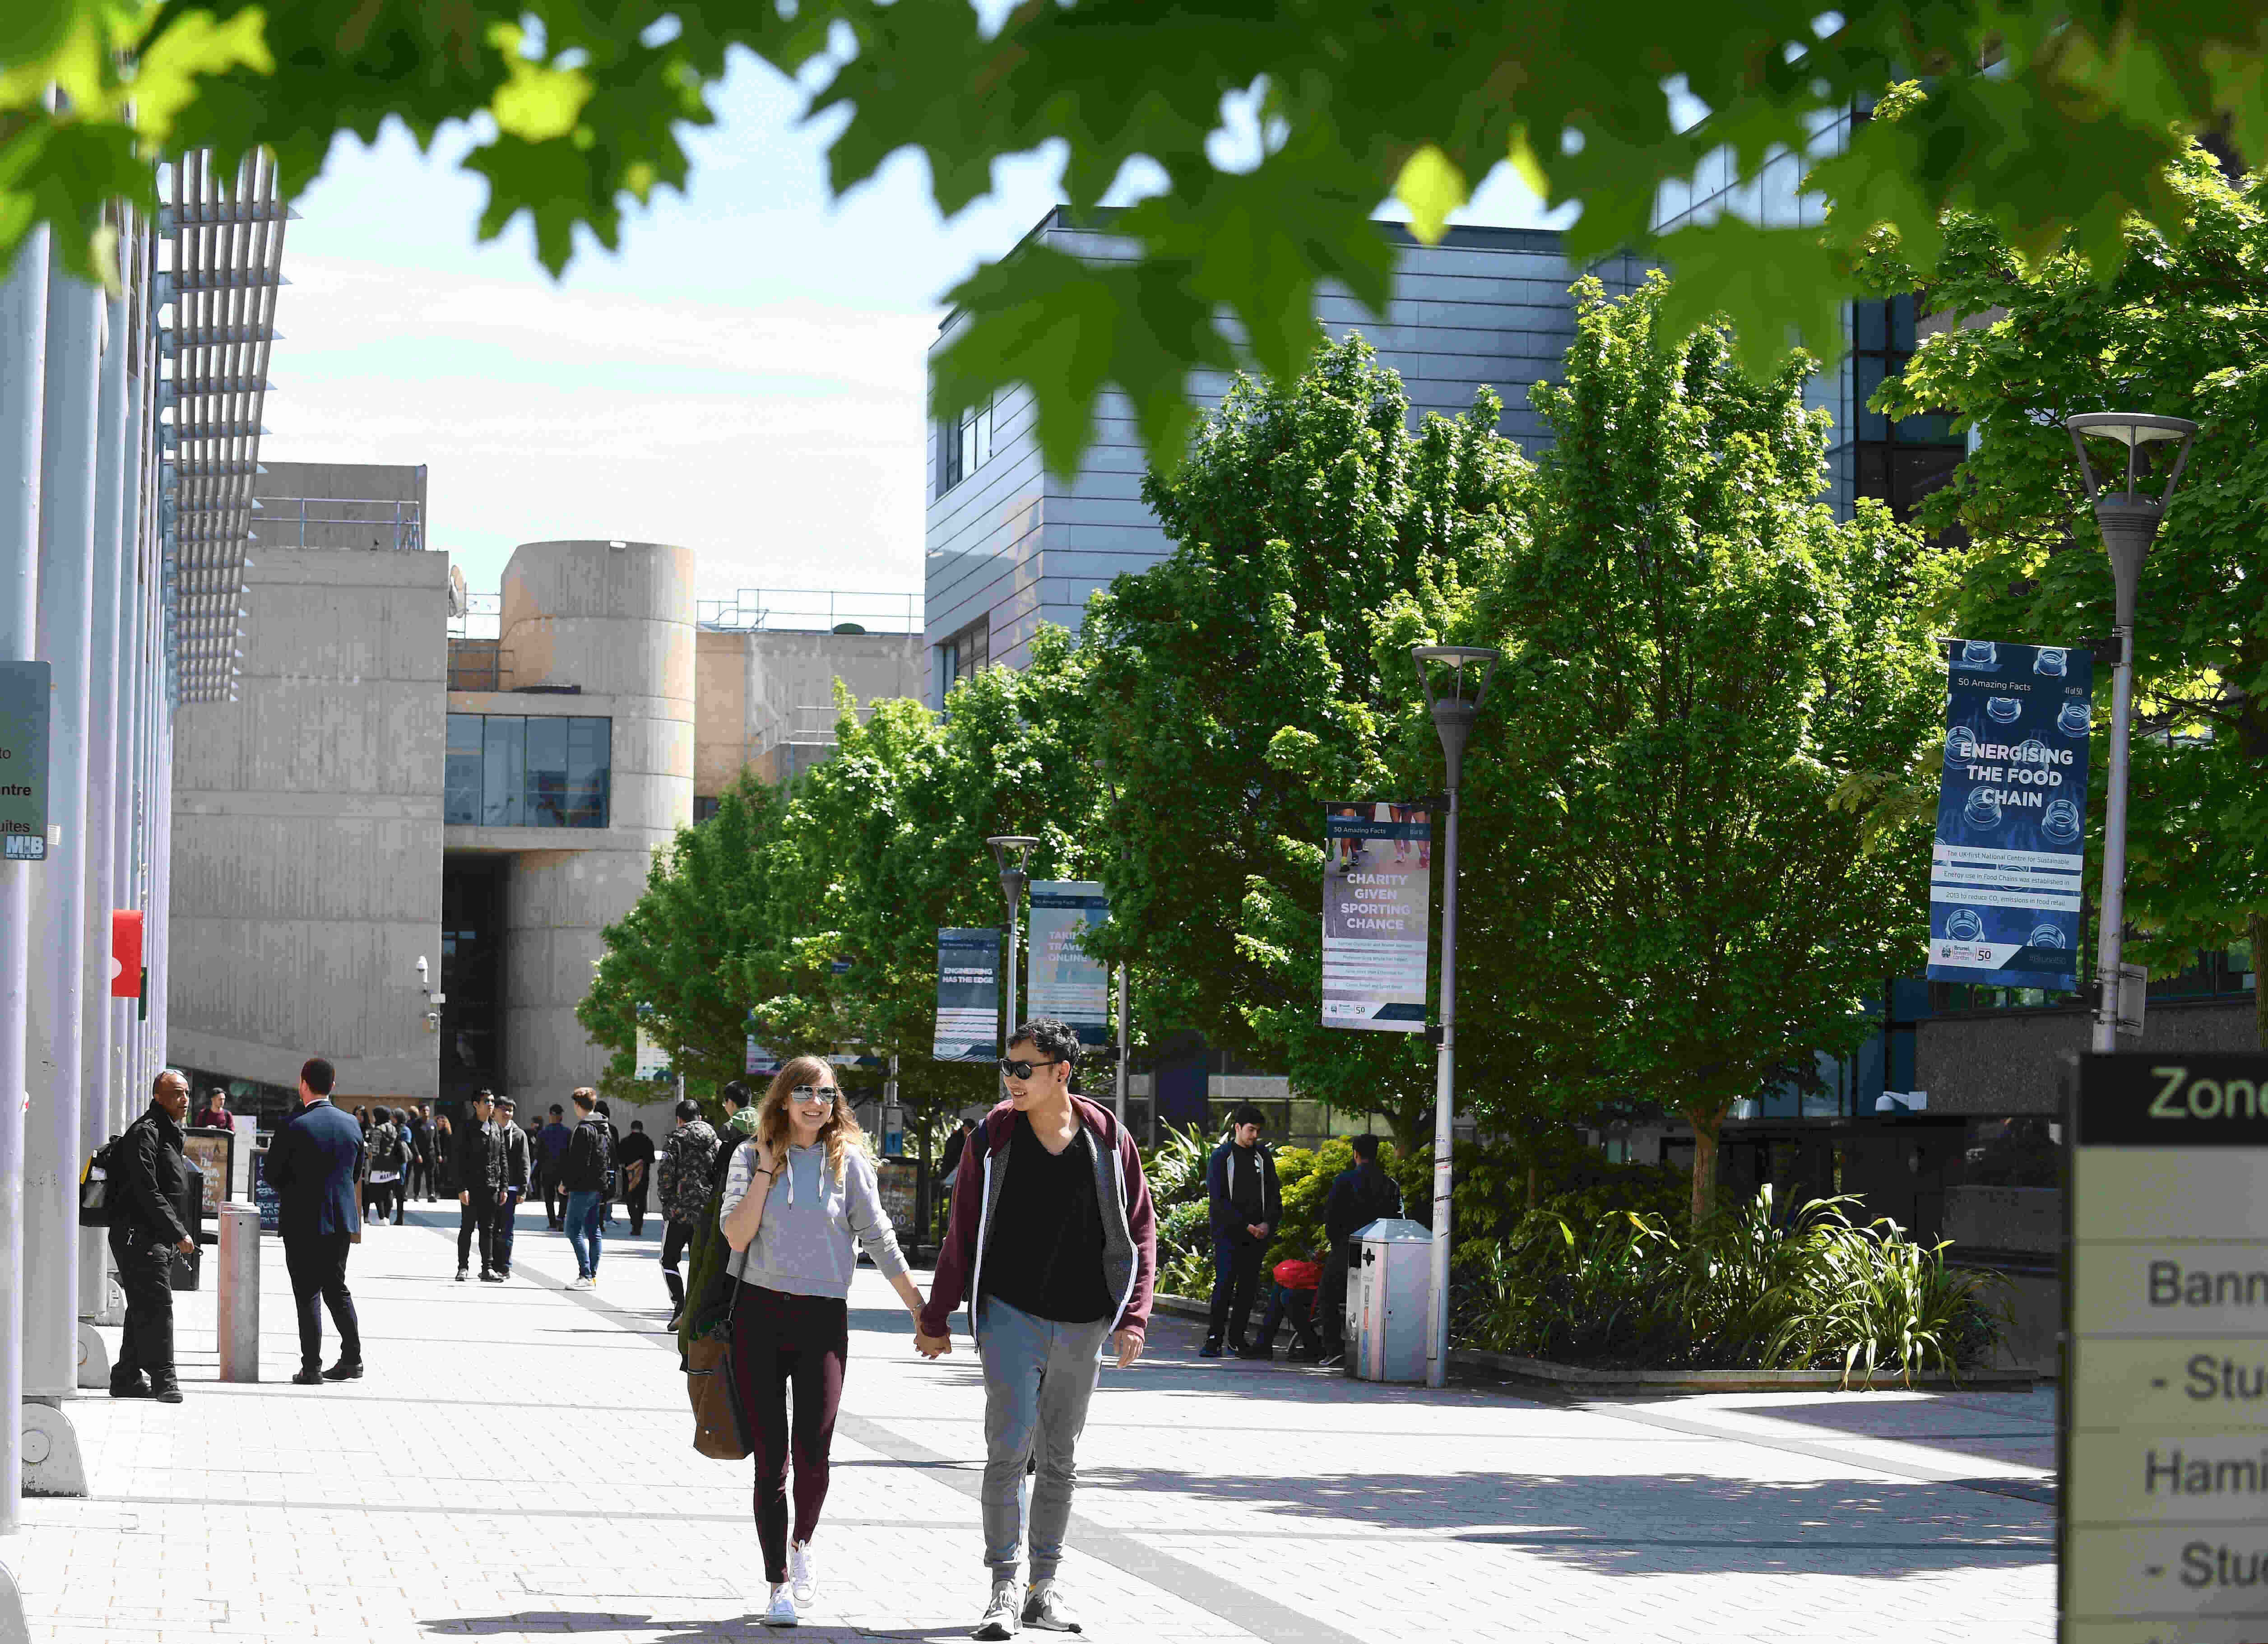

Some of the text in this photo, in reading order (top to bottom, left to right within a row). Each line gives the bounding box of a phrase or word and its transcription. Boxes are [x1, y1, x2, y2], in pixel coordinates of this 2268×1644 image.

[1971, 679, 2007, 690] Amazing
[2009, 682, 2031, 691] Facts
[1960, 743, 2073, 765] ENERGISING
[1967, 765, 2062, 786] THE FOOD
[1982, 789, 2042, 807] CHAIN
[1347, 873, 1408, 885] CHARITY
[1943, 871, 1964, 879] Energy
[1354, 888, 1397, 899] GIVEN
[1340, 903, 1412, 914] SPORTING
[1347, 918, 1405, 929] CHANCE
[1047, 953, 1087, 962] ONLINE
[1978, 950, 1991, 961] 50
[2148, 1065, 2268, 1119] Zon
[2185, 1354, 2268, 1402] Stu
[2179, 1539, 2268, 1589] Stu
